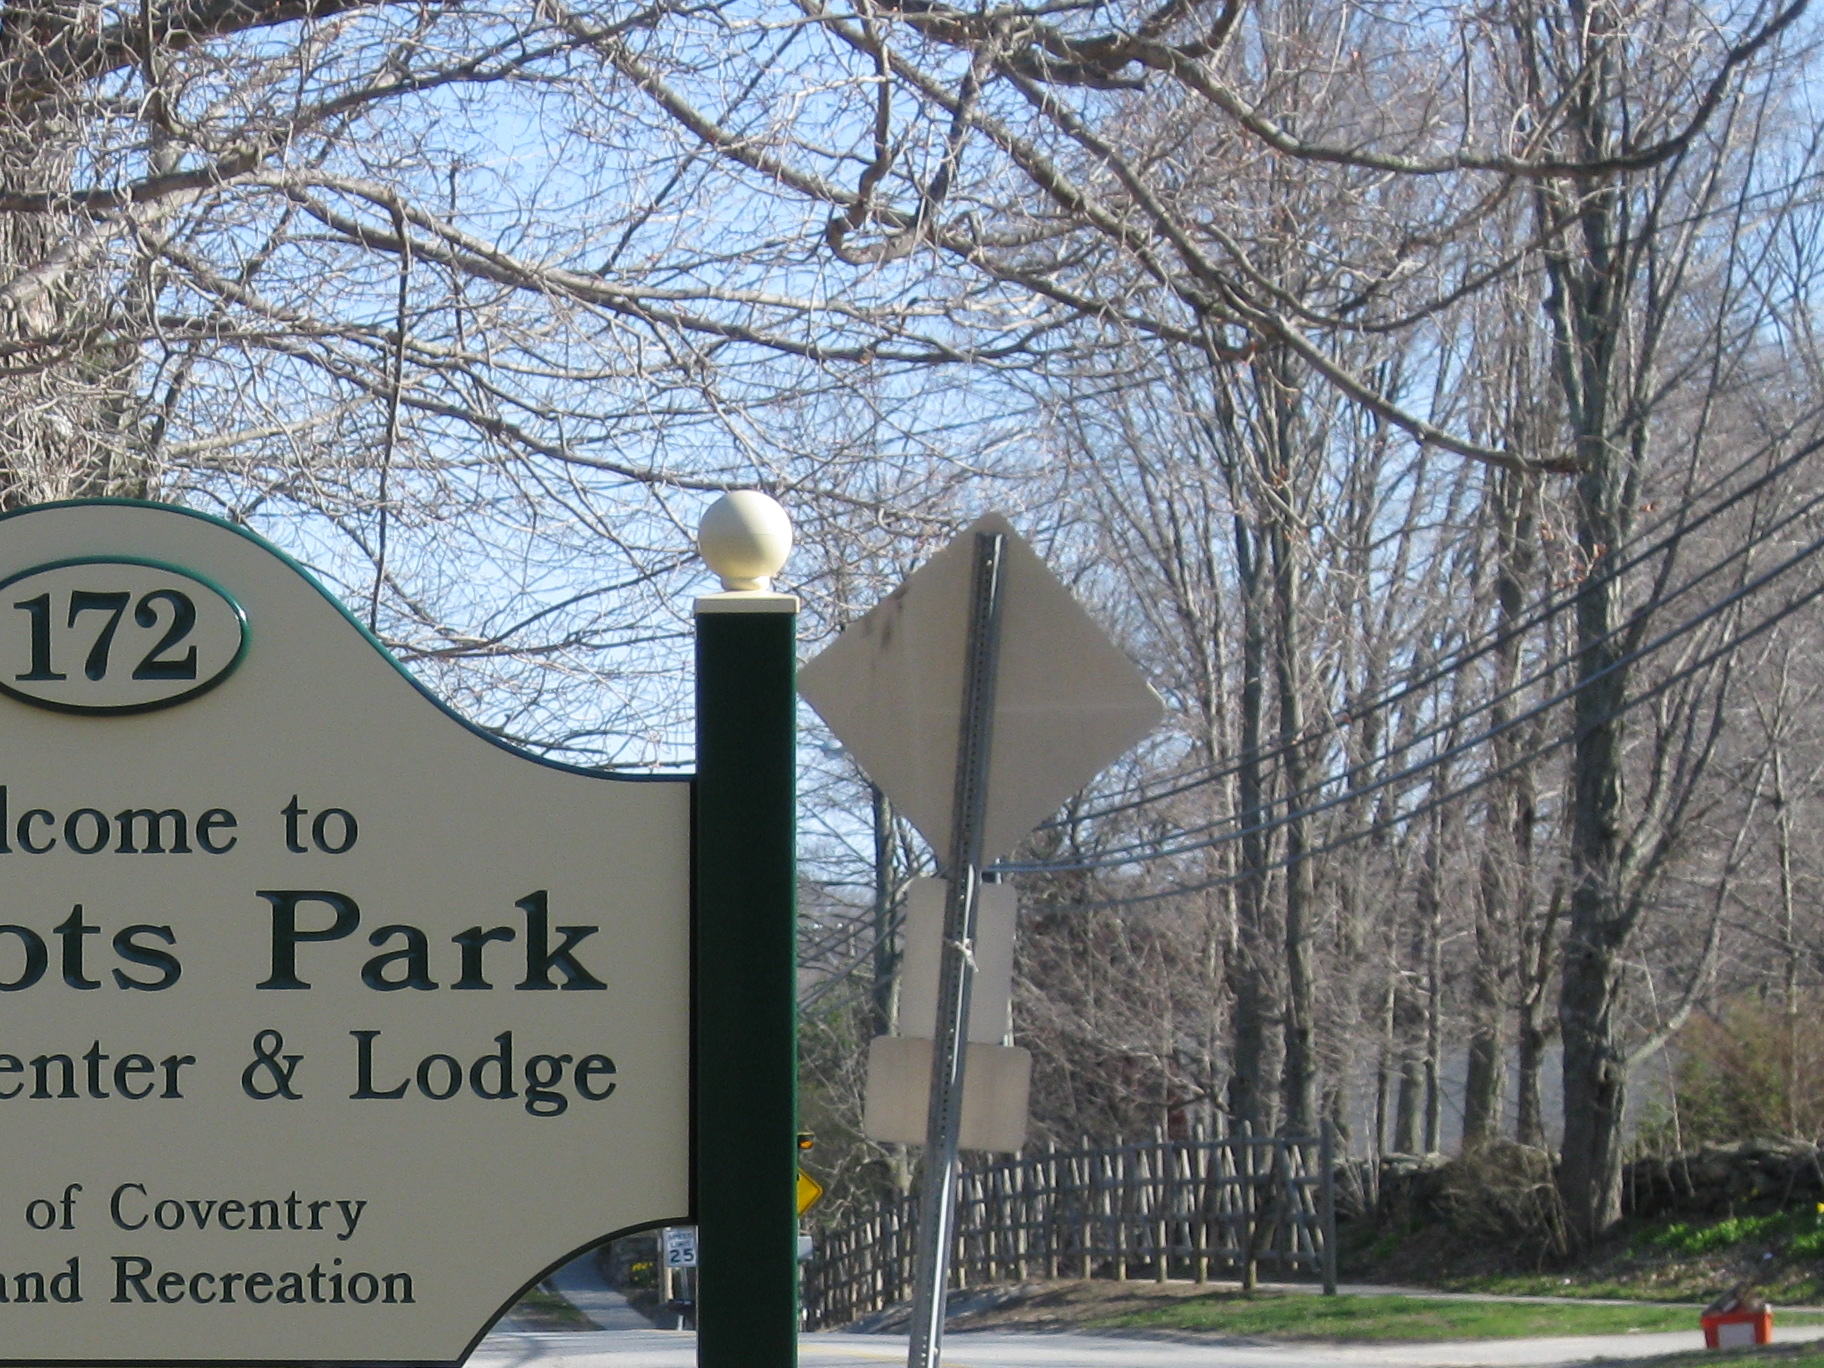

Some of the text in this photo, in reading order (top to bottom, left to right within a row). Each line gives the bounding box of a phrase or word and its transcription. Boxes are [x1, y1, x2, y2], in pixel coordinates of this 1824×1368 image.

[12, 588, 198, 682] 172
[280, 793, 359, 855] to
[255, 889, 609, 993] Park
[241, 1028, 305, 1101] &
[348, 1029, 617, 1118] Lodge
[25, 1182, 84, 1231] of
[110, 1182, 368, 1242] Coventry
[109, 1255, 417, 1305] Recreation
[670, 1248, 694, 1263] 25
